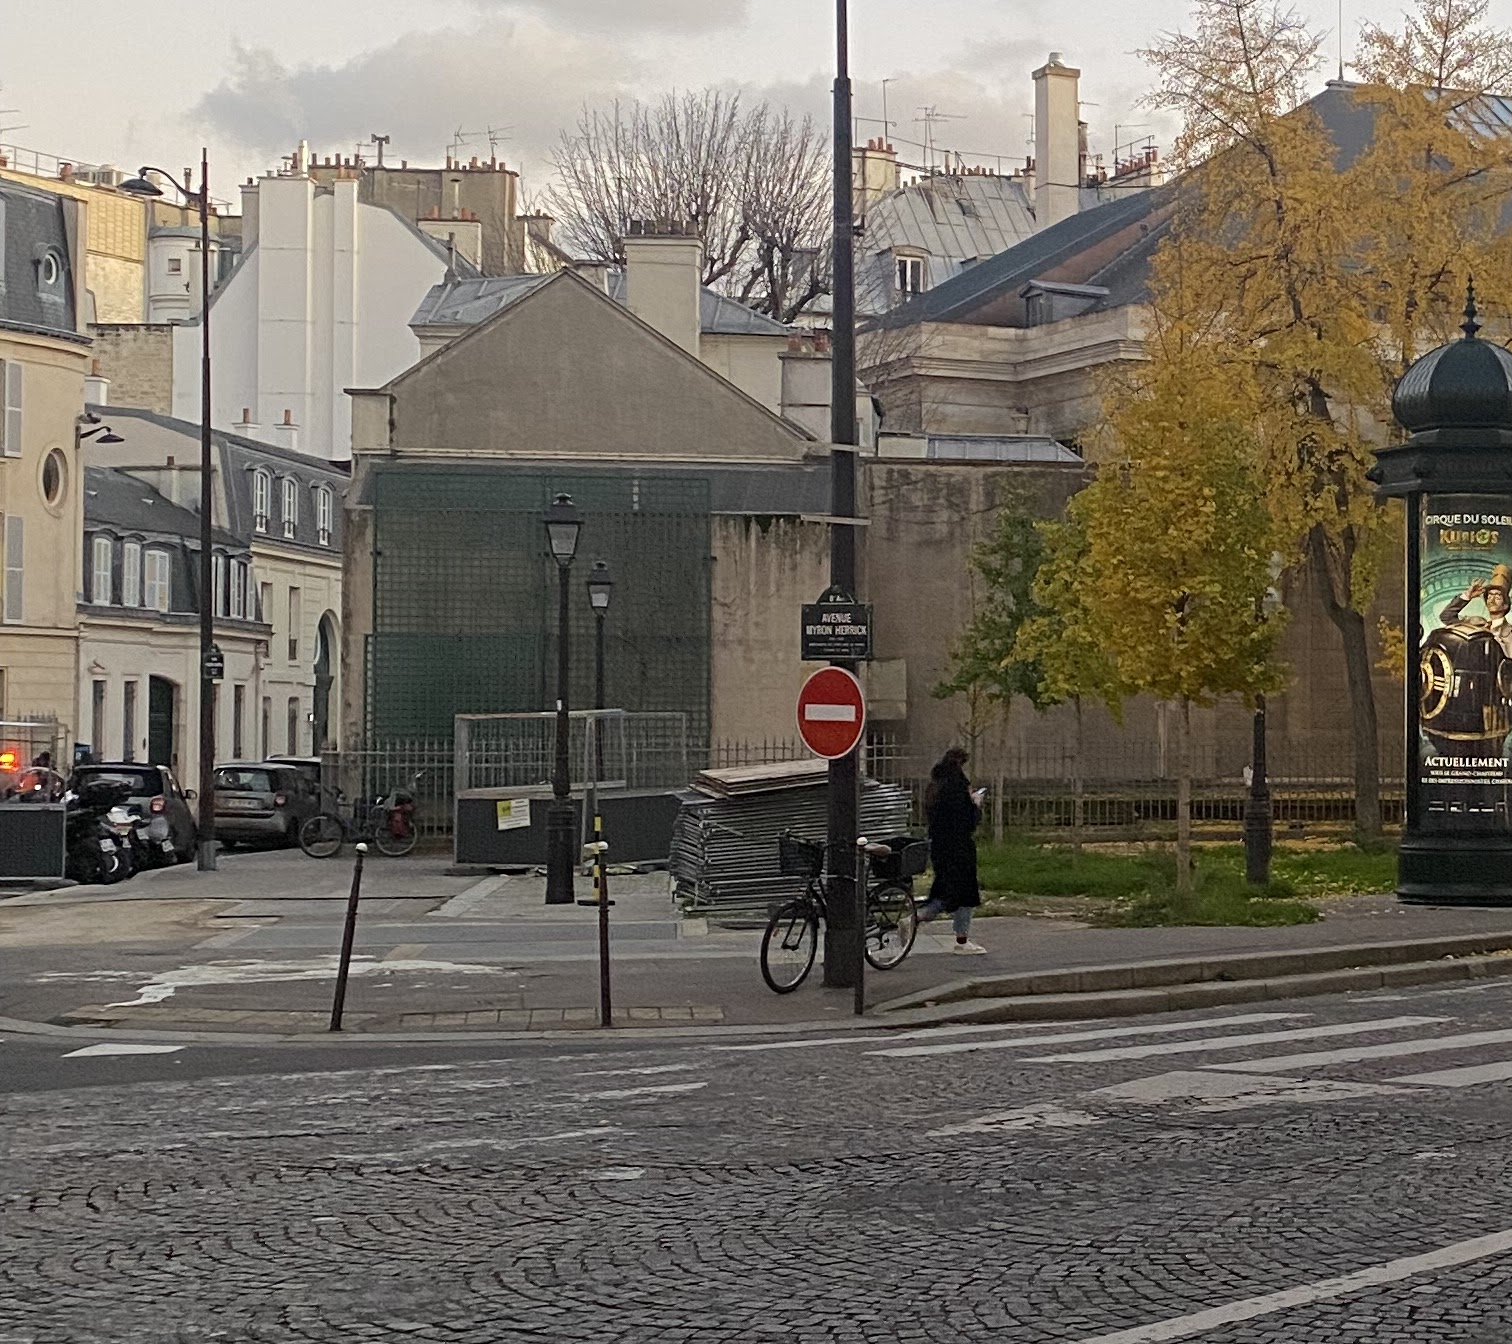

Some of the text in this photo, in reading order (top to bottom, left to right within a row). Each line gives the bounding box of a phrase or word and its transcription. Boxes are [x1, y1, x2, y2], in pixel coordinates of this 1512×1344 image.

[1425, 514, 1462, 527] CIRQUE
[1462, 514, 1480, 525] DU
[821, 613, 852, 623] AVENUE
[805, 625, 867, 635] MYRON HERRICK
[1424, 756, 1510, 767] ACTUELLEMENT
